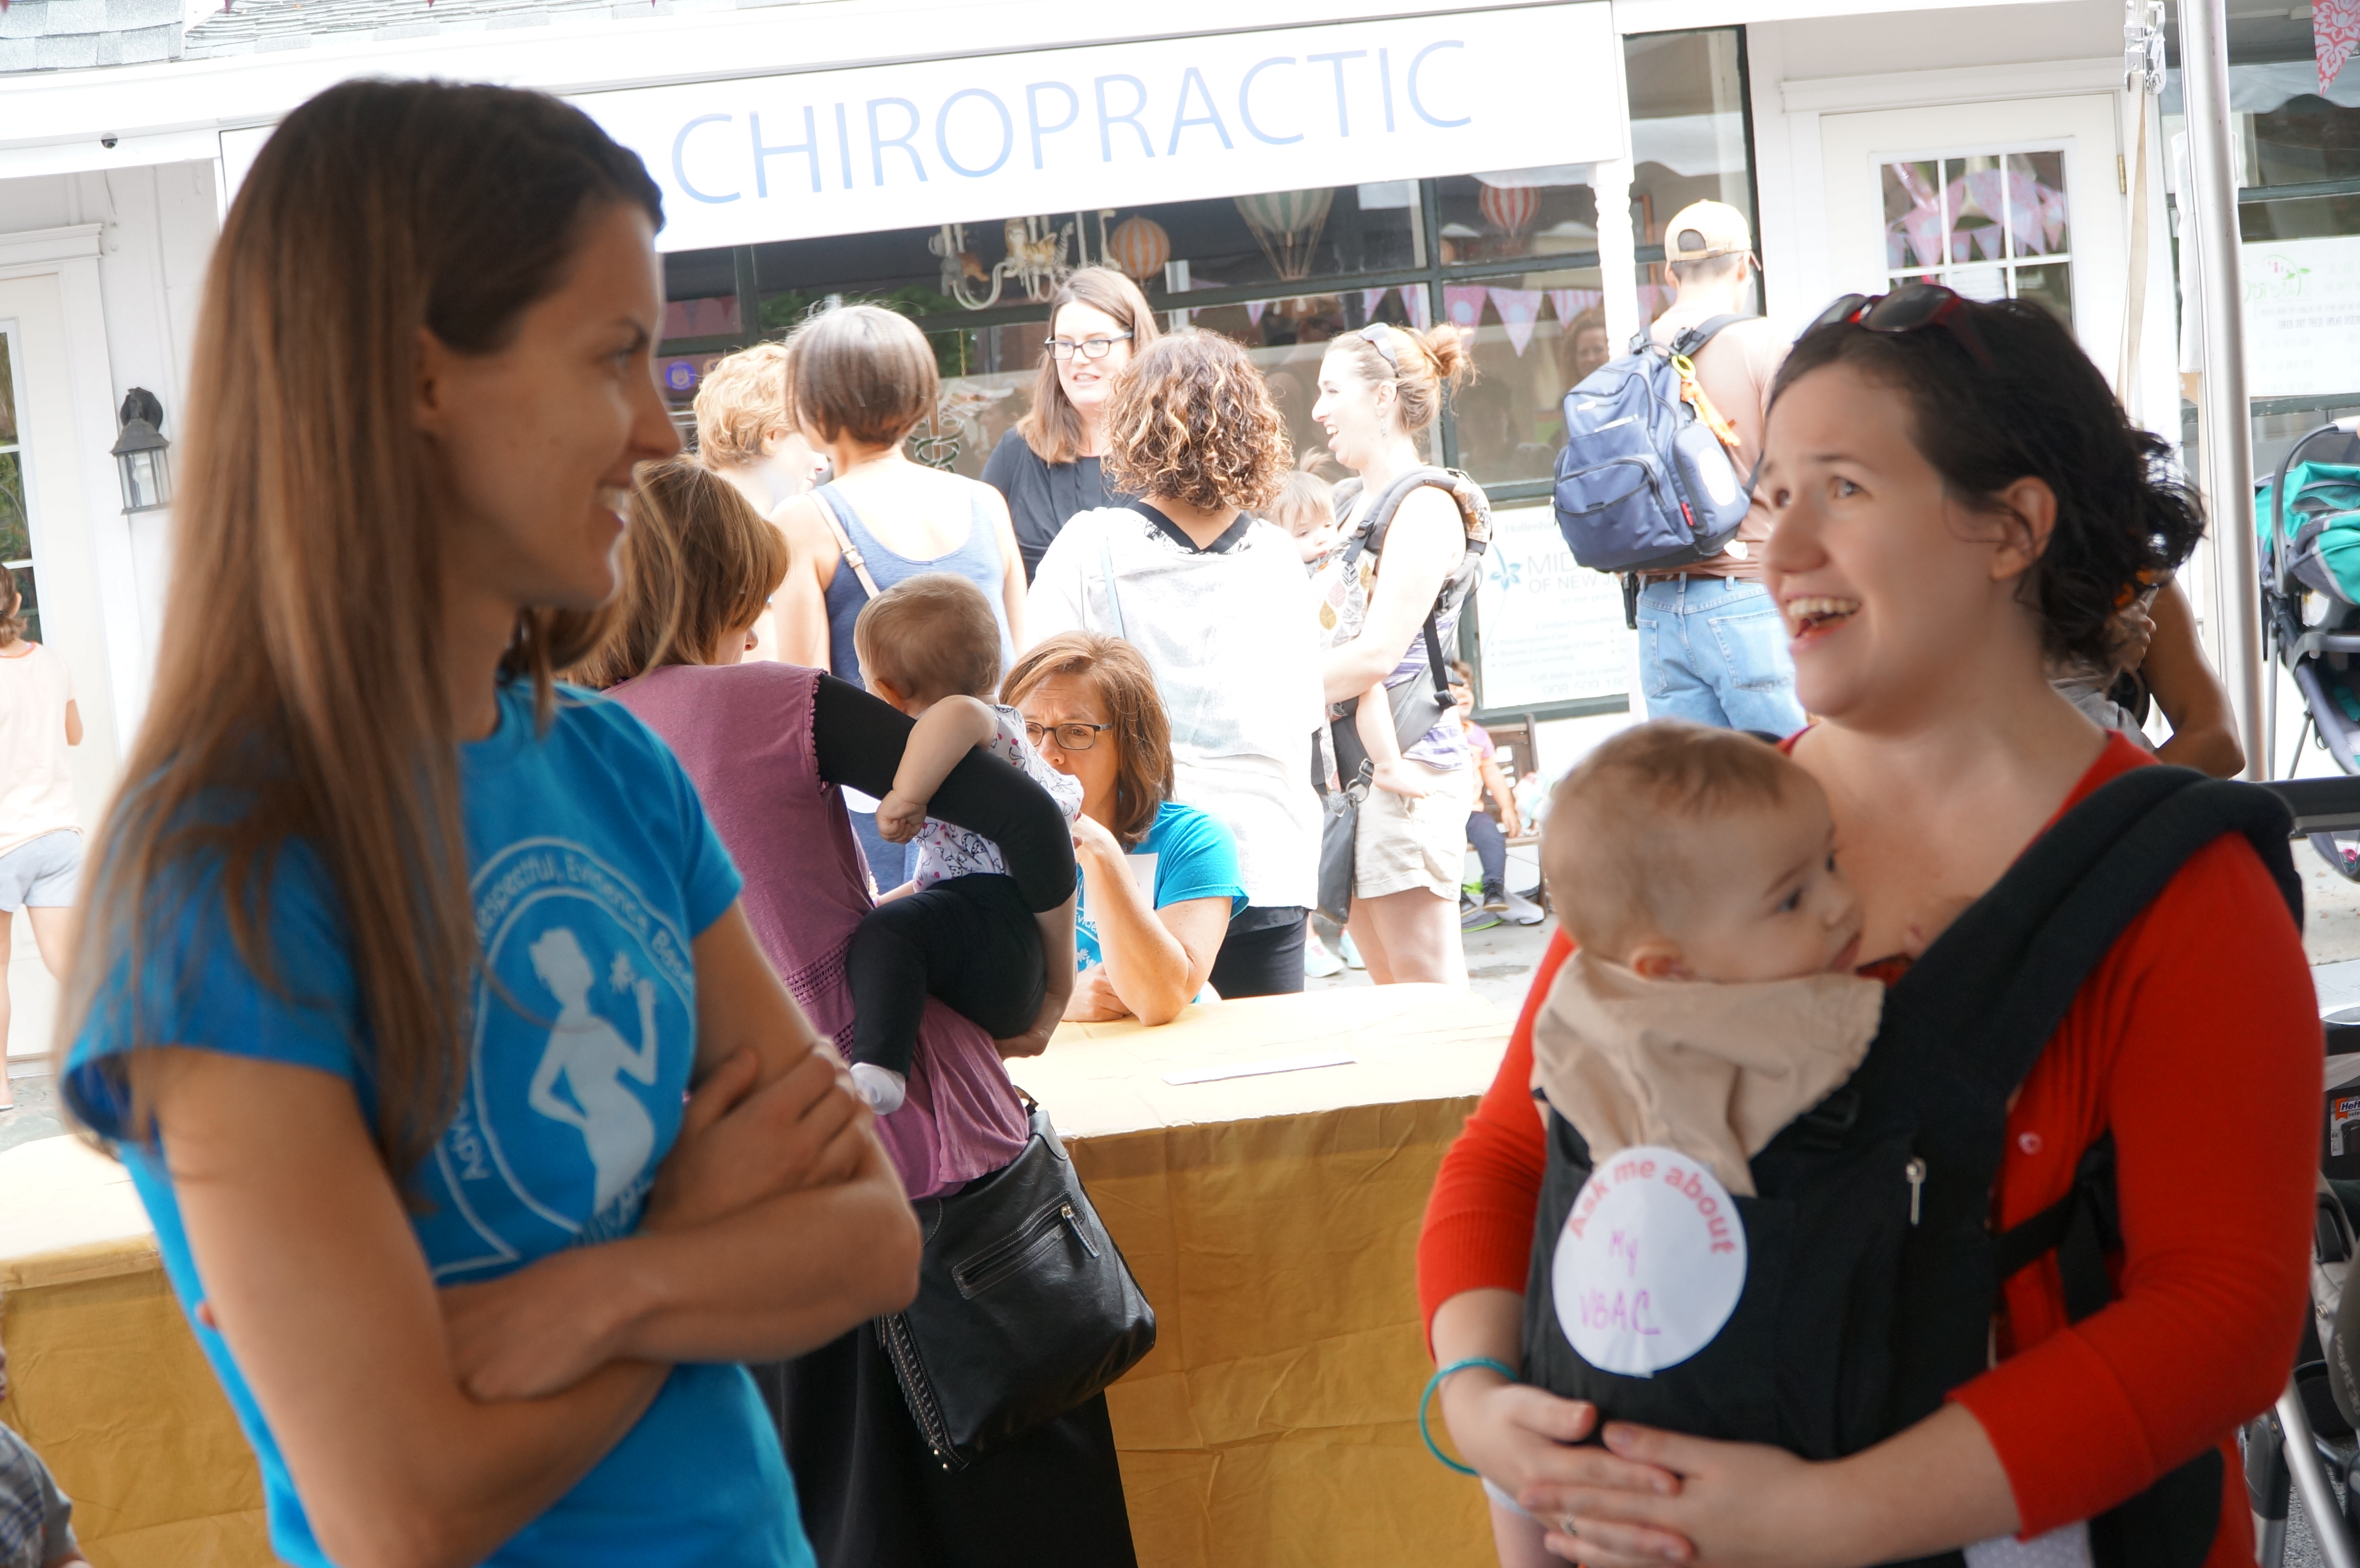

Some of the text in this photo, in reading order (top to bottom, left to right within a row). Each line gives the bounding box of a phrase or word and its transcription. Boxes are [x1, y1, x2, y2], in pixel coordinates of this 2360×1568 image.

[672, 39, 1472, 205] CHIROPRACTIC
[1527, 552, 1577, 576] MID
[1528, 574, 1620, 593] OF NEW JE
[1614, 1159, 1656, 1185] me
[1664, 1166, 1737, 1255] about
